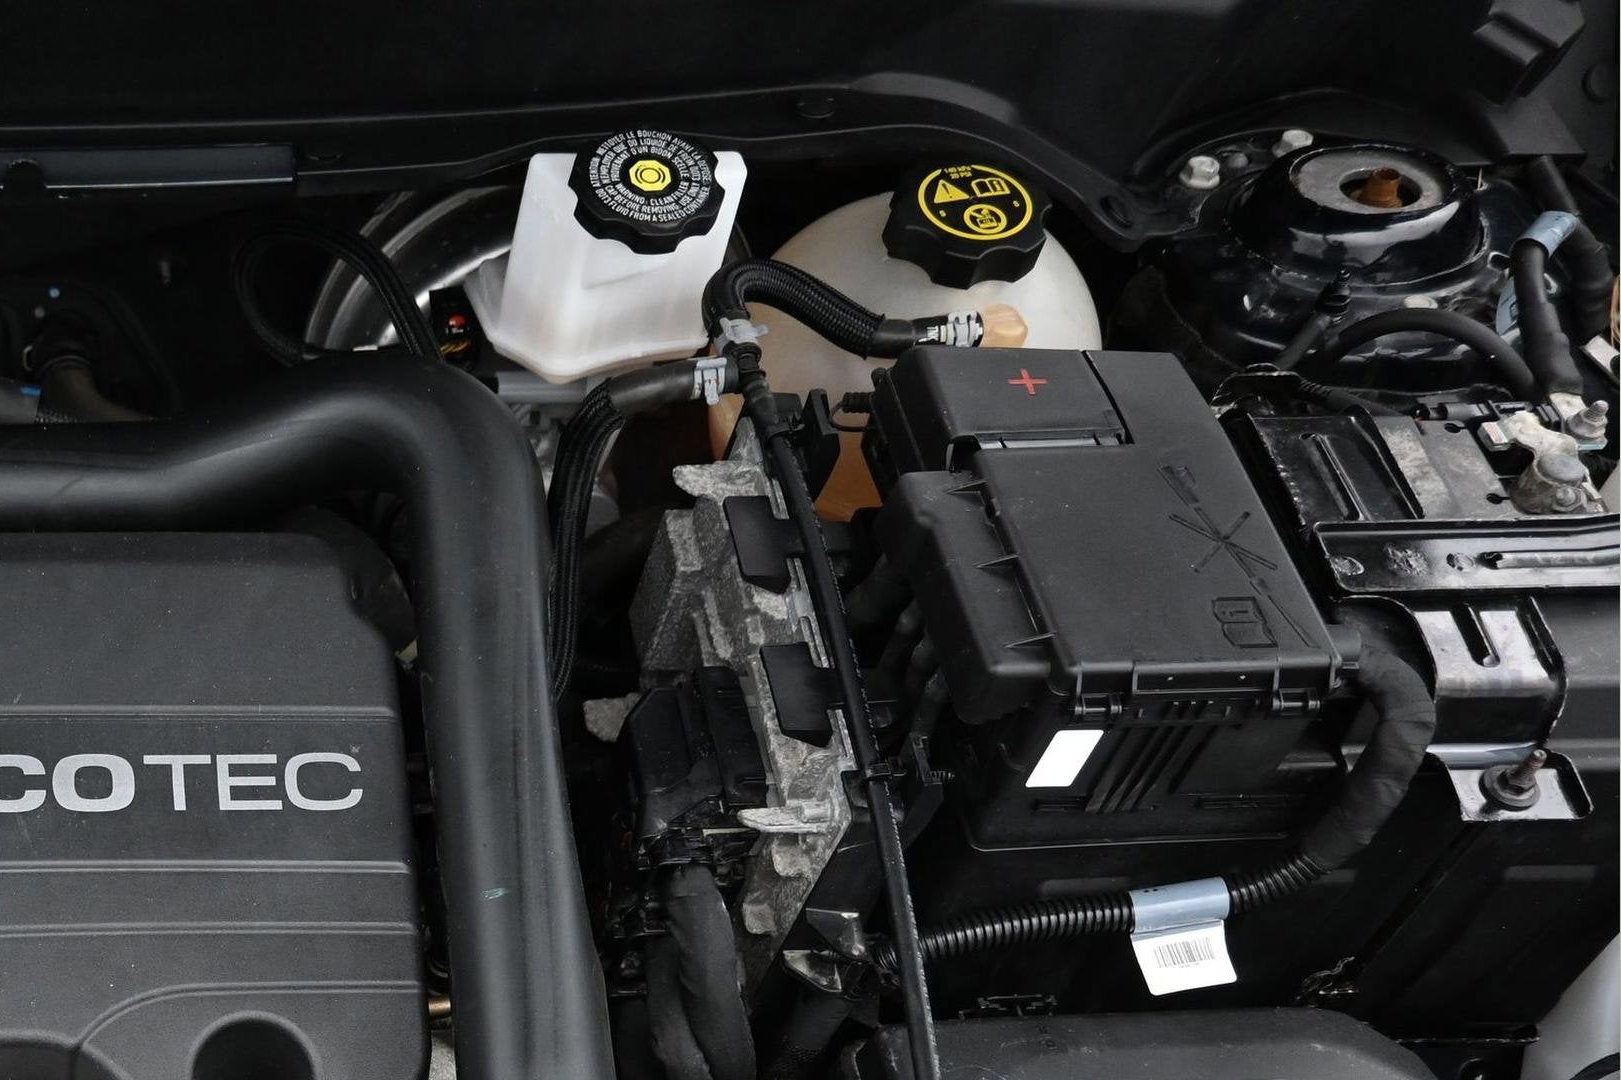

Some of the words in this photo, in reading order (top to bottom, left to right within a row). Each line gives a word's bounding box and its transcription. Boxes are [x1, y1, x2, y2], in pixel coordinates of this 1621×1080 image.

[613, 141, 627, 153] QUE
[640, 138, 667, 147] LIQUIDE
[668, 144, 678, 152] DE
[632, 146, 648, 155] D'UN
[651, 147, 674, 158] BIDON
[637, 130, 672, 141] BOUCHON
[672, 137, 693, 153] AVANT
[692, 151, 701, 160] LA
[605, 185, 617, 196] CAP
[614, 194, 640, 211] BEFORE
[680, 196, 693, 206] USE
[687, 182, 700, 197] ONLY
[650, 195, 674, 205] CLEAN
[674, 181, 689, 199] FILLER
[608, 201, 629, 215] FLUID
[629, 210, 651, 221] FROM
[652, 213, 657, 221] A
[659, 209, 687, 222] SEALED
